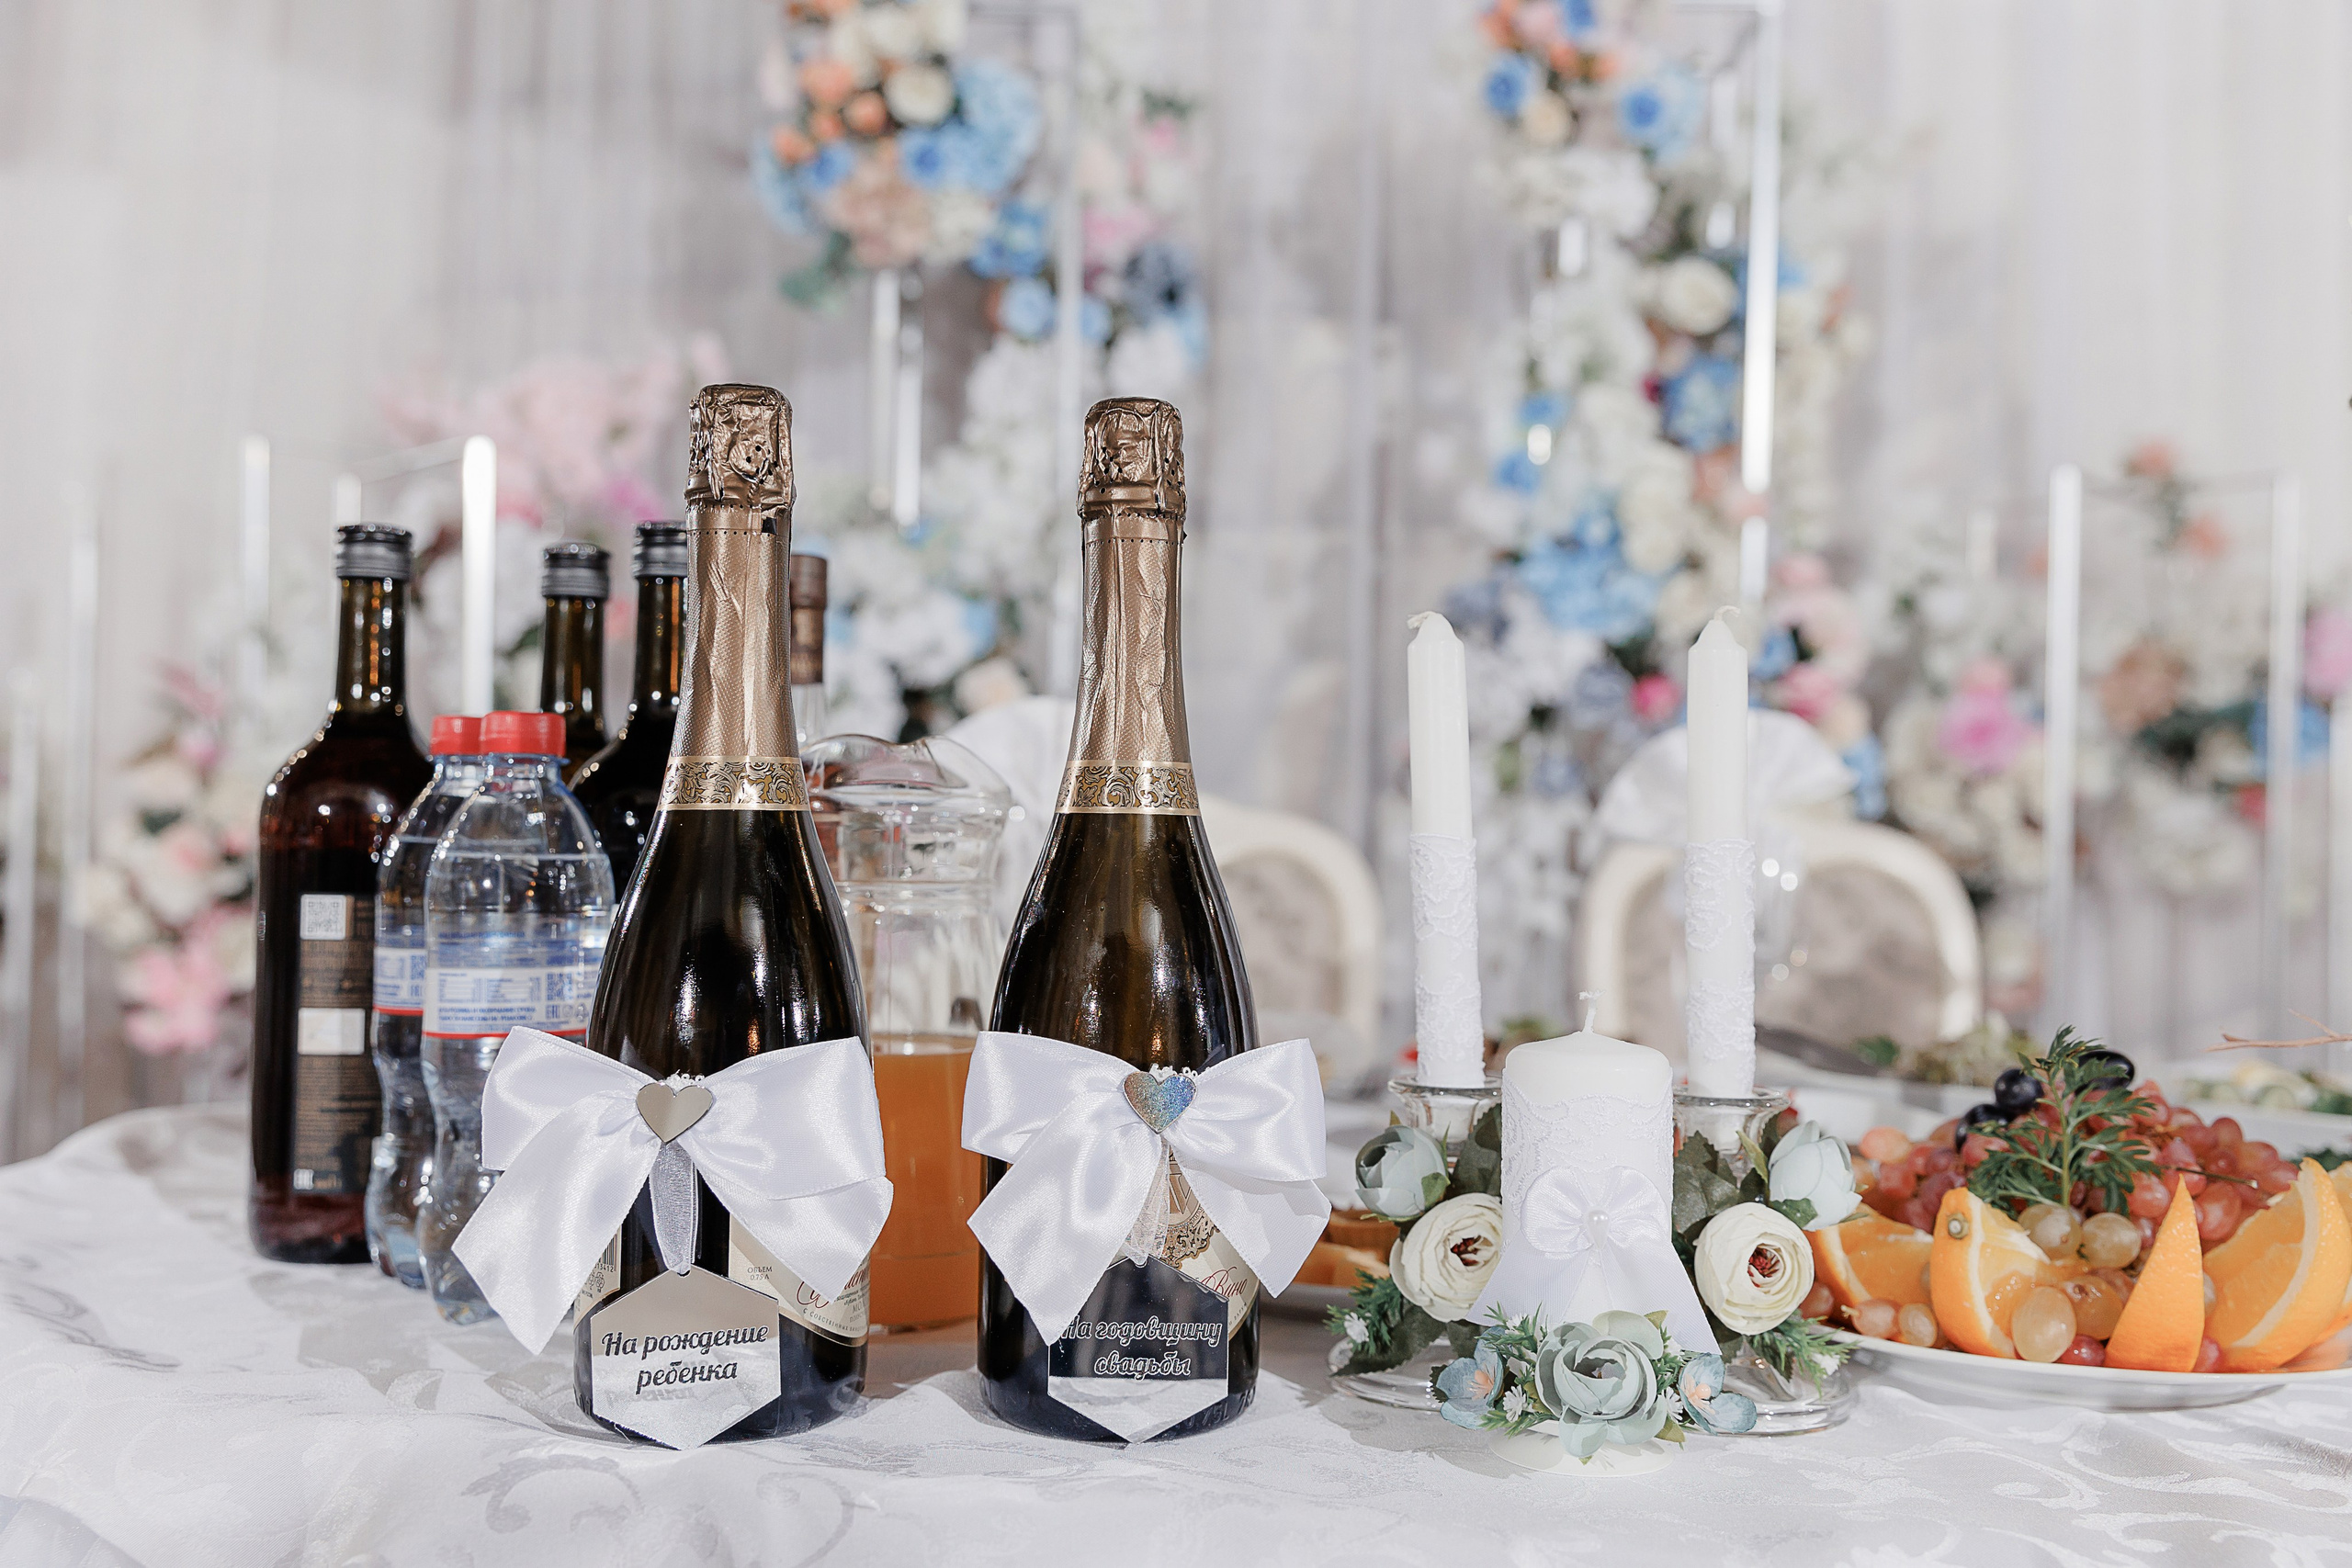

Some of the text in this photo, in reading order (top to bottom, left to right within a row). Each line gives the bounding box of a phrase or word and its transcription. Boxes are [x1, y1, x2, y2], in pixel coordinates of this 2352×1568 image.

[602, 1325, 770, 1360] На рождение
[1095, 1314, 1223, 1347] годовщину
[635, 1359, 738, 1395] ребенка
[1093, 1349, 1192, 1381] свадьбы
